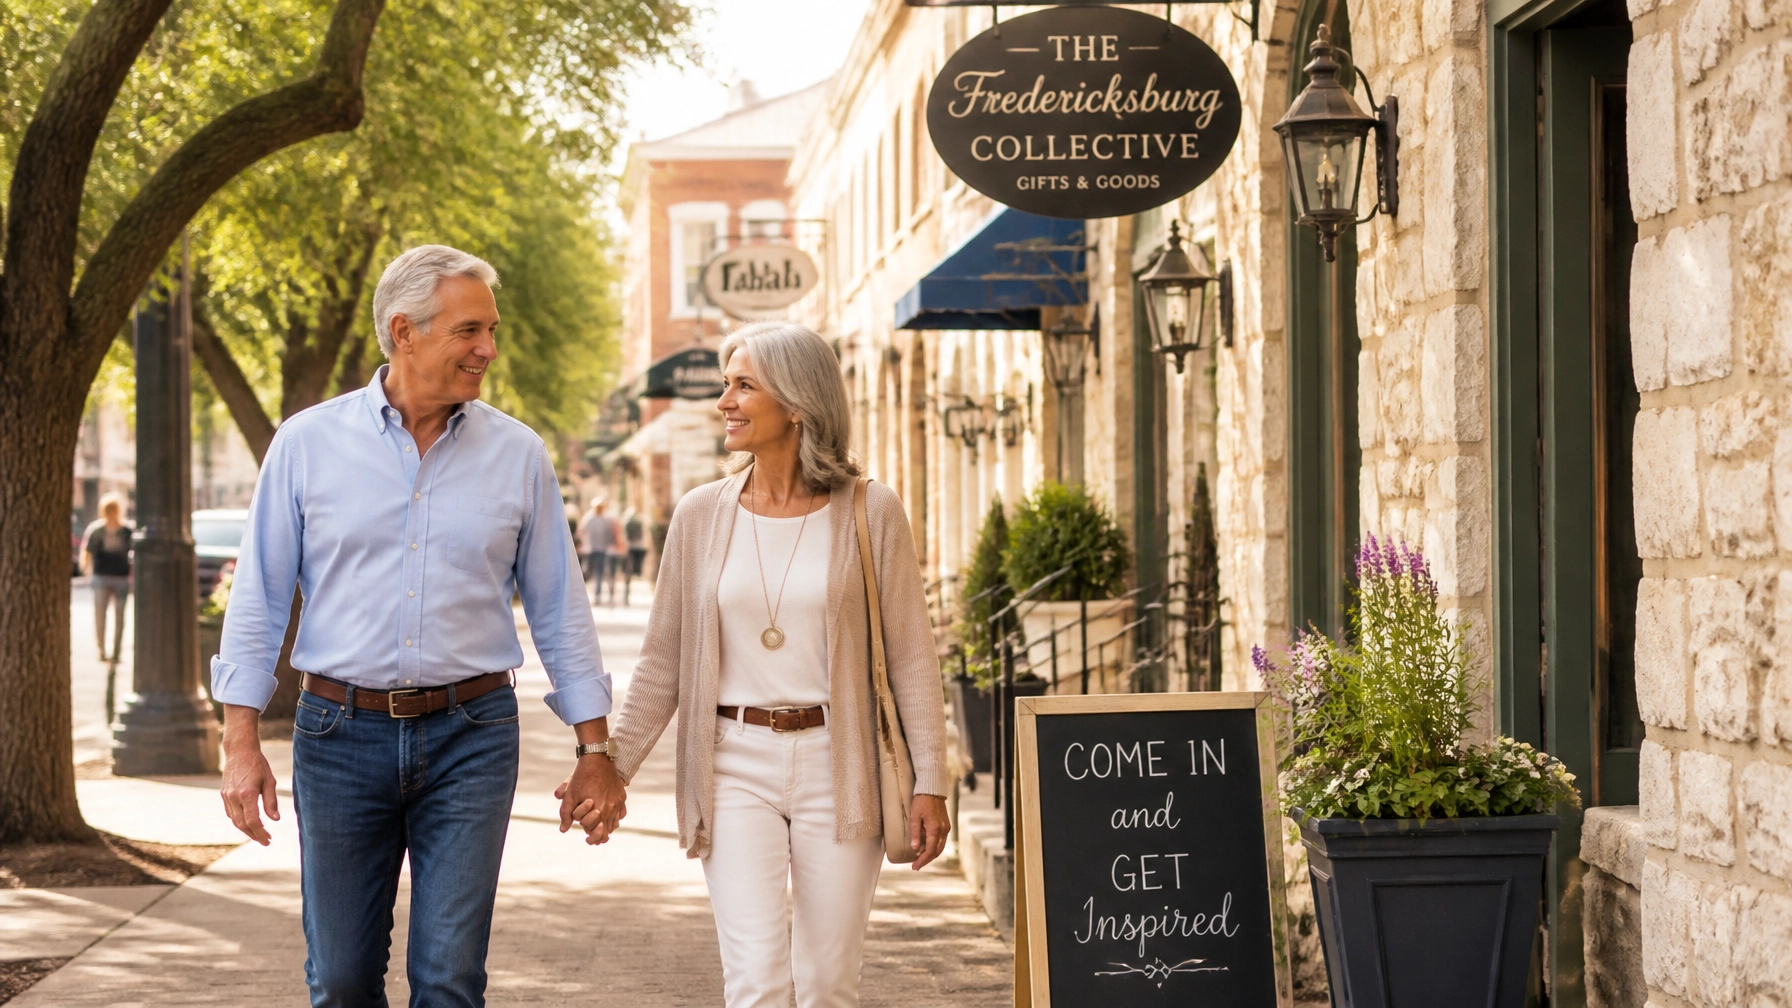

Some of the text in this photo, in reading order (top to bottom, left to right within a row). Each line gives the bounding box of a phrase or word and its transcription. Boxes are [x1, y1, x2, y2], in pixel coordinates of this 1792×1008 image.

[1047, 35, 1119, 61] THE
[948, 69, 1223, 130] Fredericksburg
[970, 133, 1199, 162] COLLECTIVE
[1016, 174, 1160, 190] GIFTS & GOODS
[1064, 738, 1226, 780] COME IN
[1110, 791, 1181, 829] and
[1111, 853, 1189, 892] GET
[1074, 891, 1240, 958] Inspired
